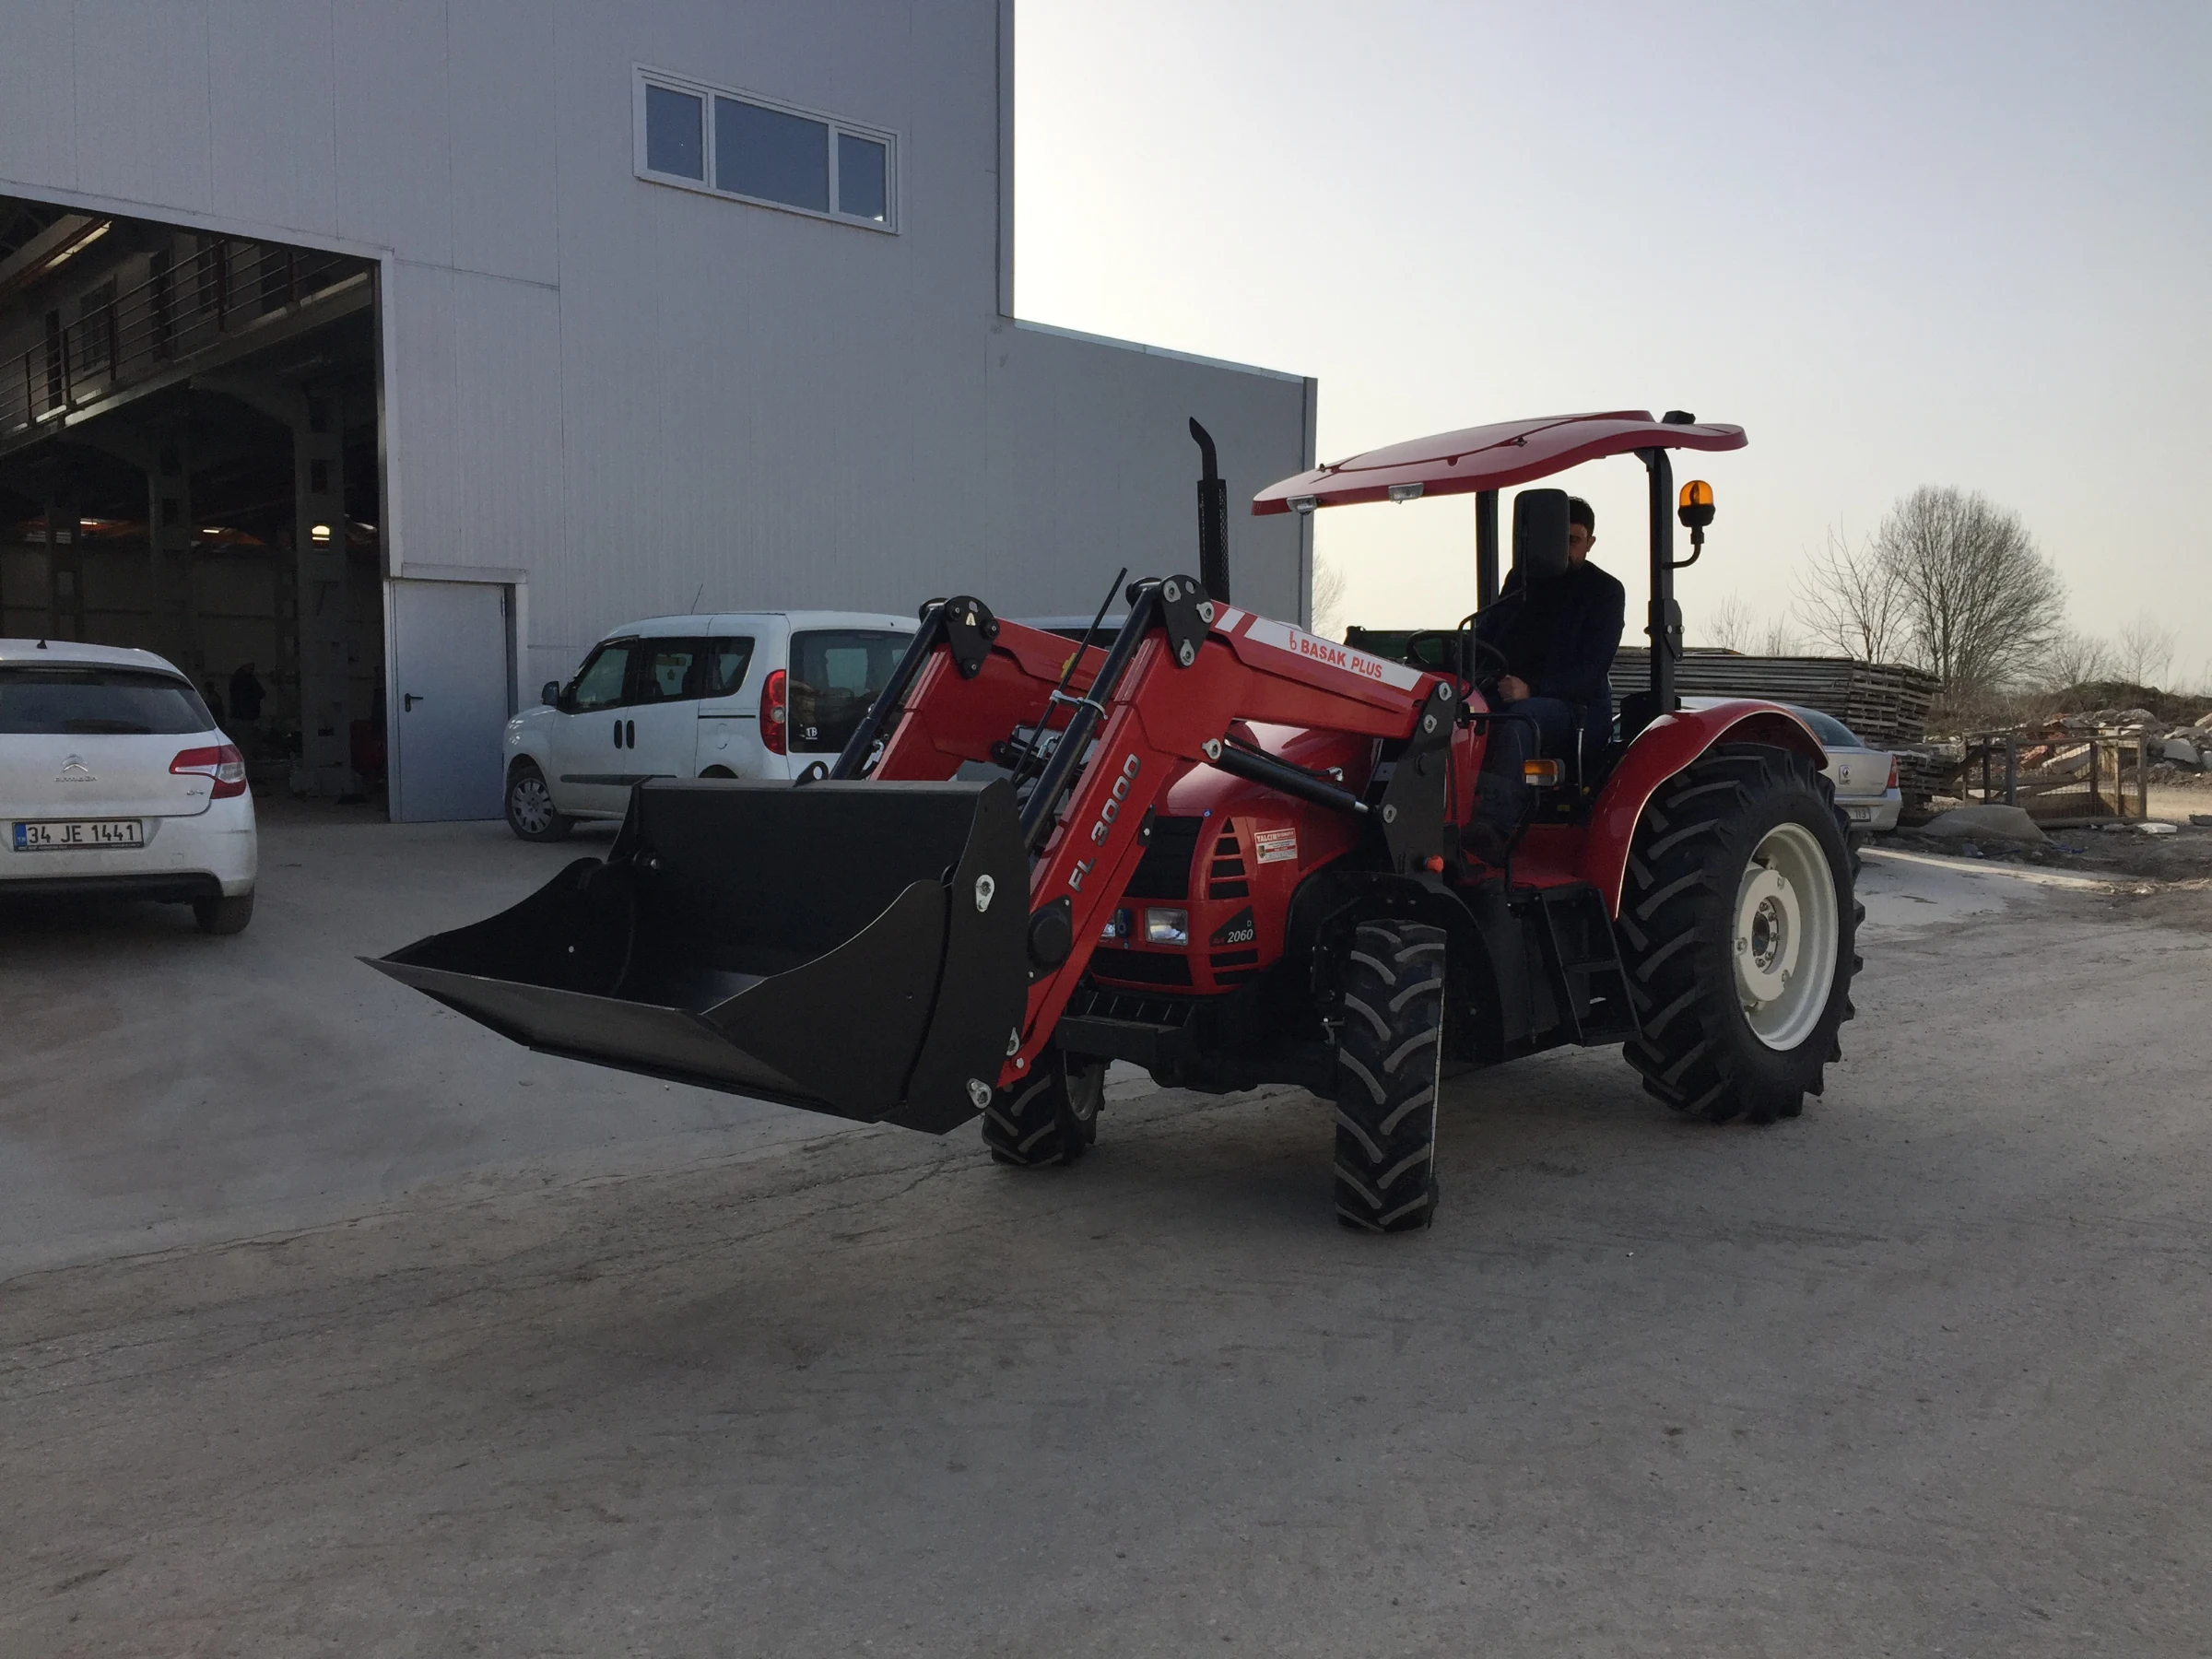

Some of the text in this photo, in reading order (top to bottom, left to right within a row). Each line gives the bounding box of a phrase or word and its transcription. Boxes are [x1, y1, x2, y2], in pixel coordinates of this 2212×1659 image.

[1300, 639, 1382, 678] BASAK PLUS
[28, 826, 51, 844] 34
[61, 825, 83, 842] JE
[91, 824, 135, 842] 1441
[1067, 753, 1141, 893] FL 3000
[1227, 928, 1253, 944] 2060
